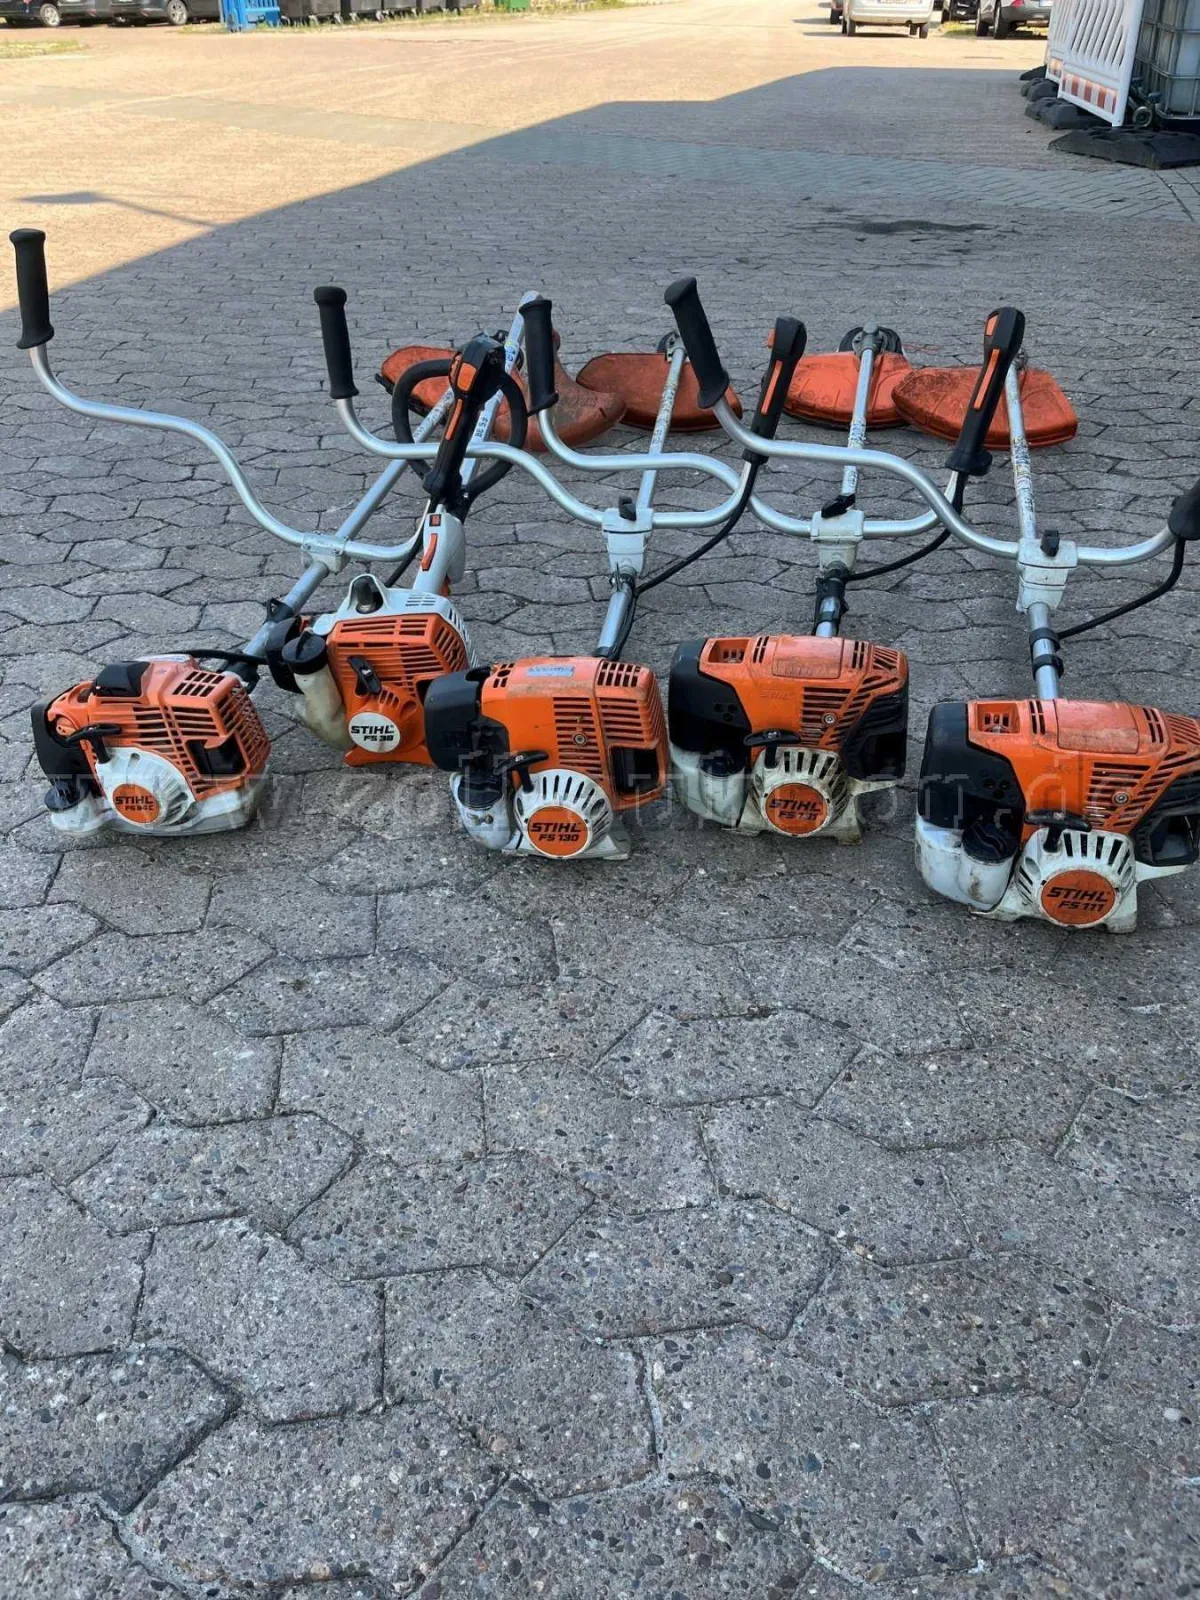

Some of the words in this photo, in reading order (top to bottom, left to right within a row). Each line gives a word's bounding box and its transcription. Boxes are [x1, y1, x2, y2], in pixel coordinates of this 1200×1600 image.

[351, 725, 395, 734] STIHL
[115, 795, 154, 805] STIHL
[769, 799, 821, 812] STIHL
[779, 811, 796, 819] FS
[531, 822, 581, 832] STIHL
[539, 833, 556, 841] FS
[558, 833, 580, 841] 130
[1047, 887, 1109, 902] STIHL
[1057, 901, 1081, 910] FS
[1081, 903, 1105, 912] 111
